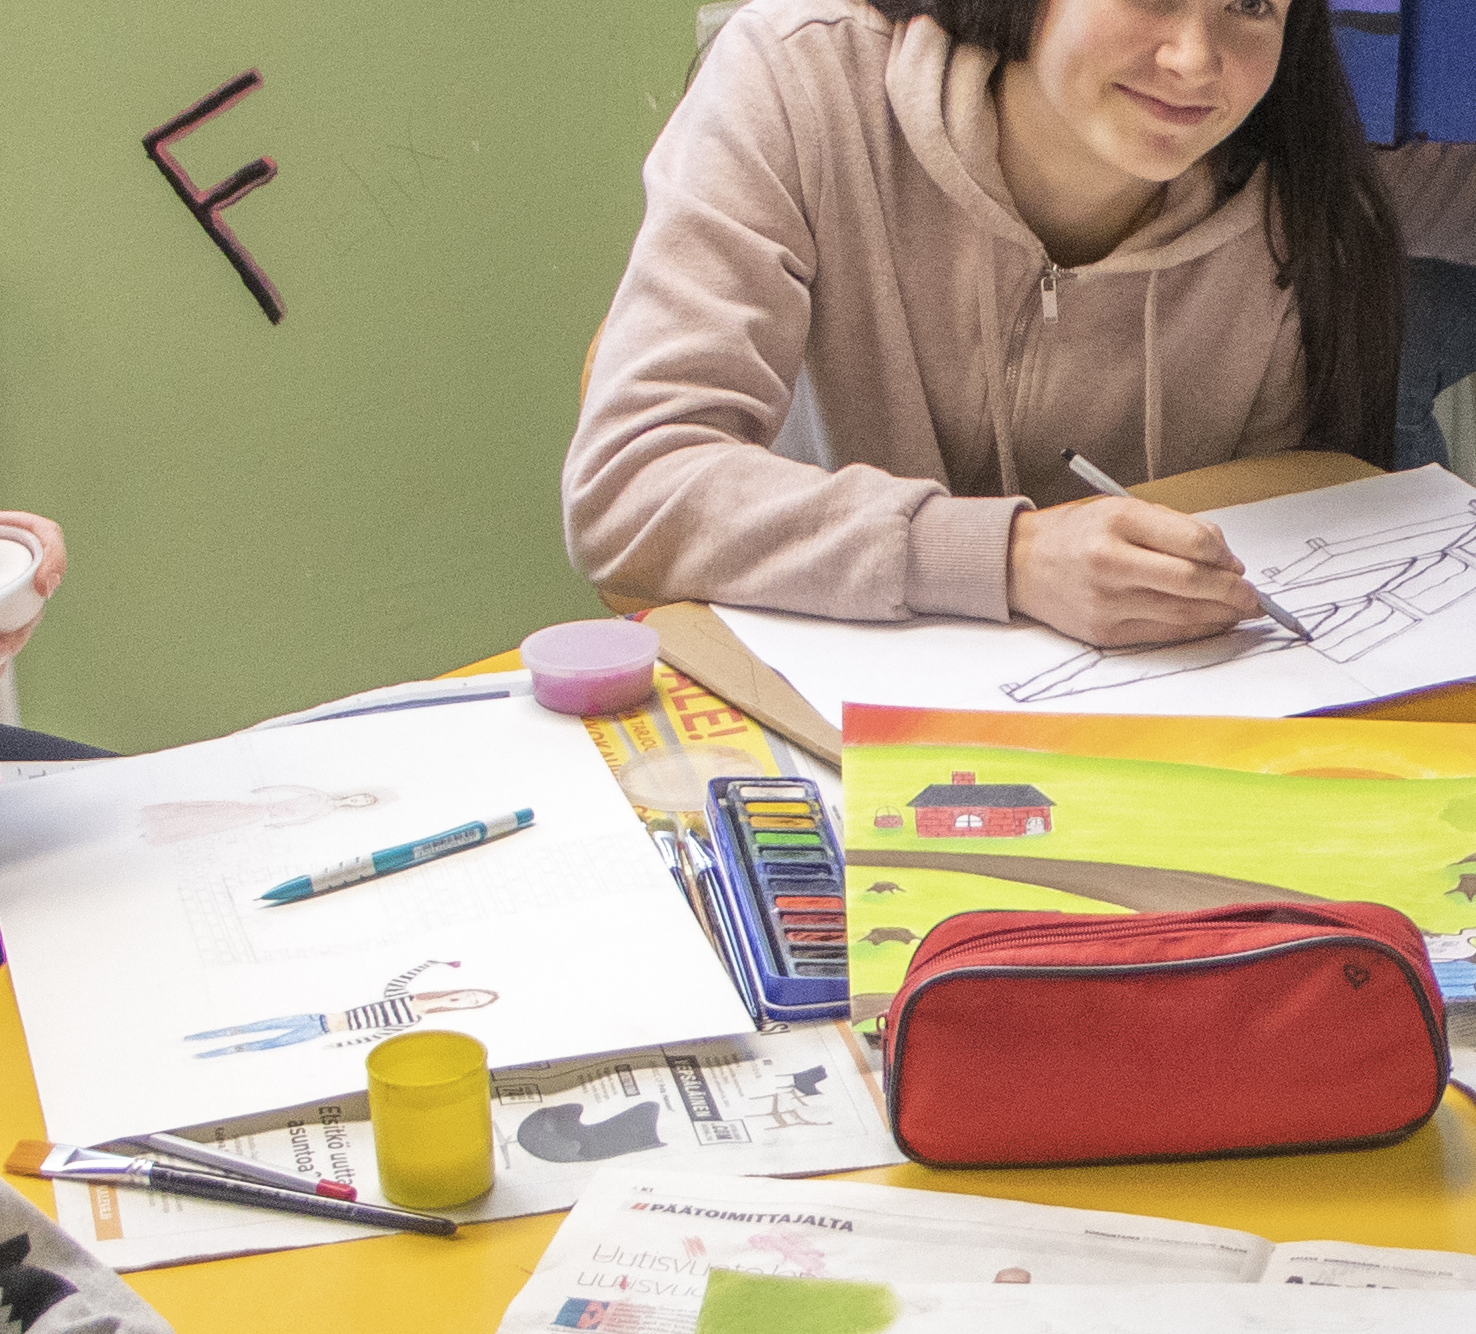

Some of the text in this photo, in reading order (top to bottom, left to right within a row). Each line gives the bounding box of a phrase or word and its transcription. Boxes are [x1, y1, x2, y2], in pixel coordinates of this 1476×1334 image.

[141, 67, 285, 328] F
[287, 1119, 315, 1173] asuntoa
[648, 1201, 855, 1233] PÄÄTOIMITTAJALTA
